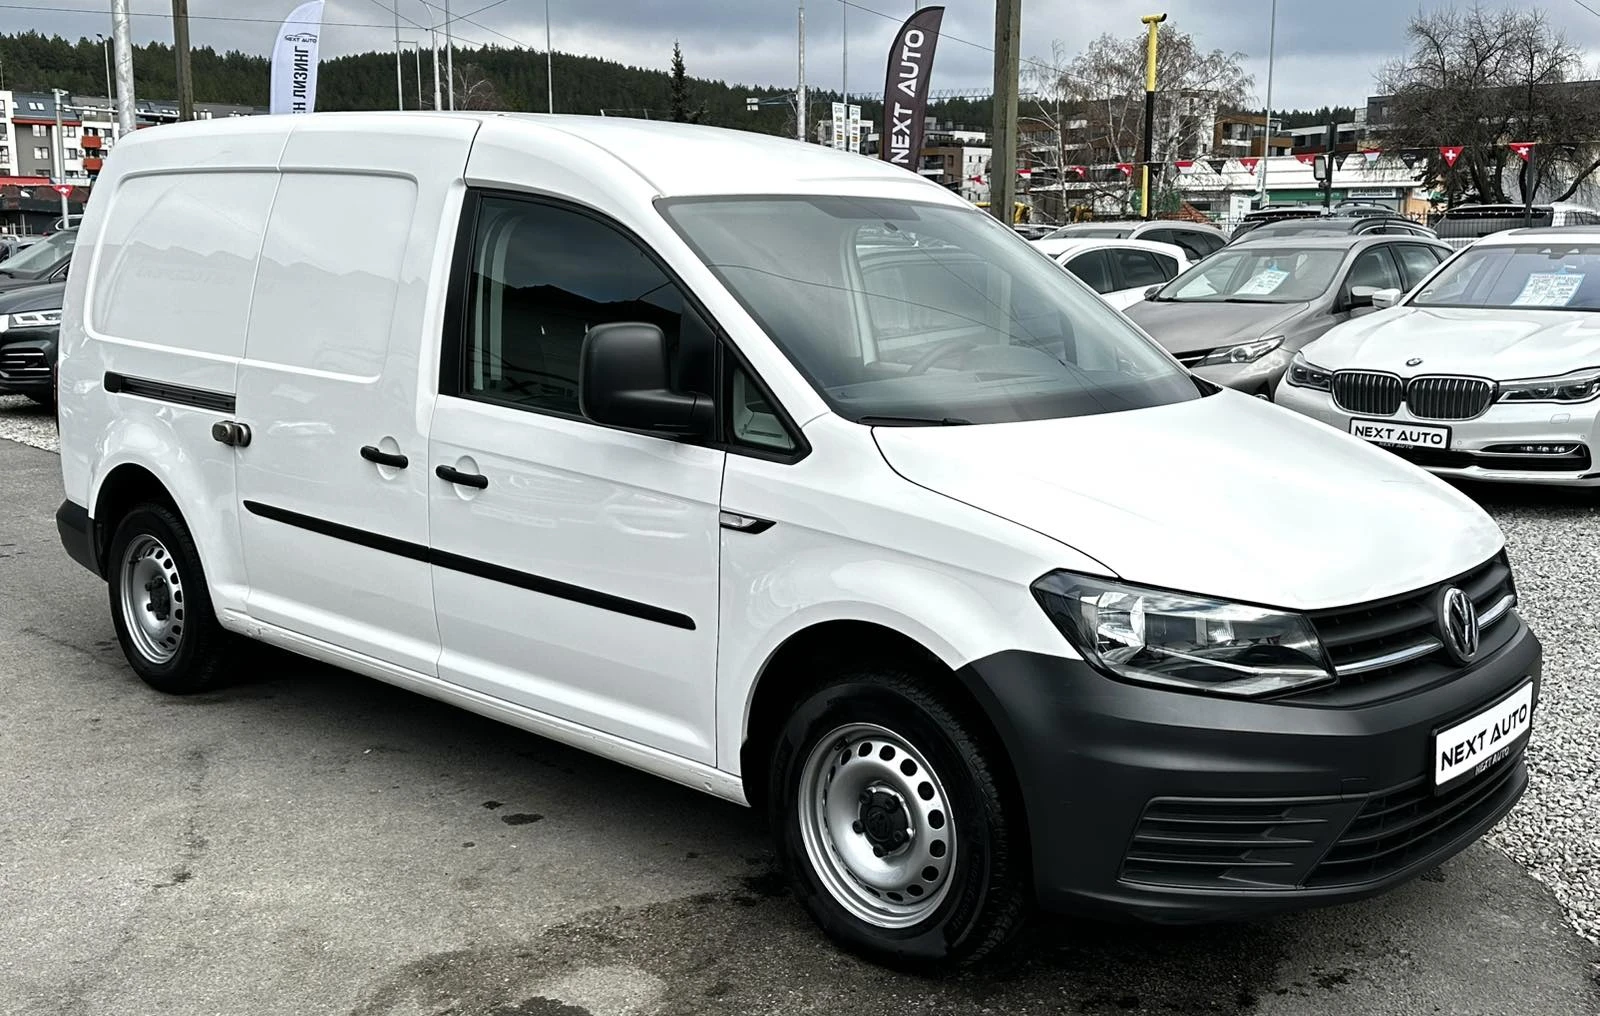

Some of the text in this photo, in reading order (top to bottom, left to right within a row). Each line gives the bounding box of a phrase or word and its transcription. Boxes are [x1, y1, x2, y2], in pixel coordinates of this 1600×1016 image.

[293, 46, 309, 99] ЛИЗИНГ
[891, 30, 924, 163] NEXT AUTO
[1355, 426, 1442, 444] NEXT AUTO
[1441, 703, 1528, 771] NEXT AUTO
[1475, 747, 1509, 776] NEXT AUTO
